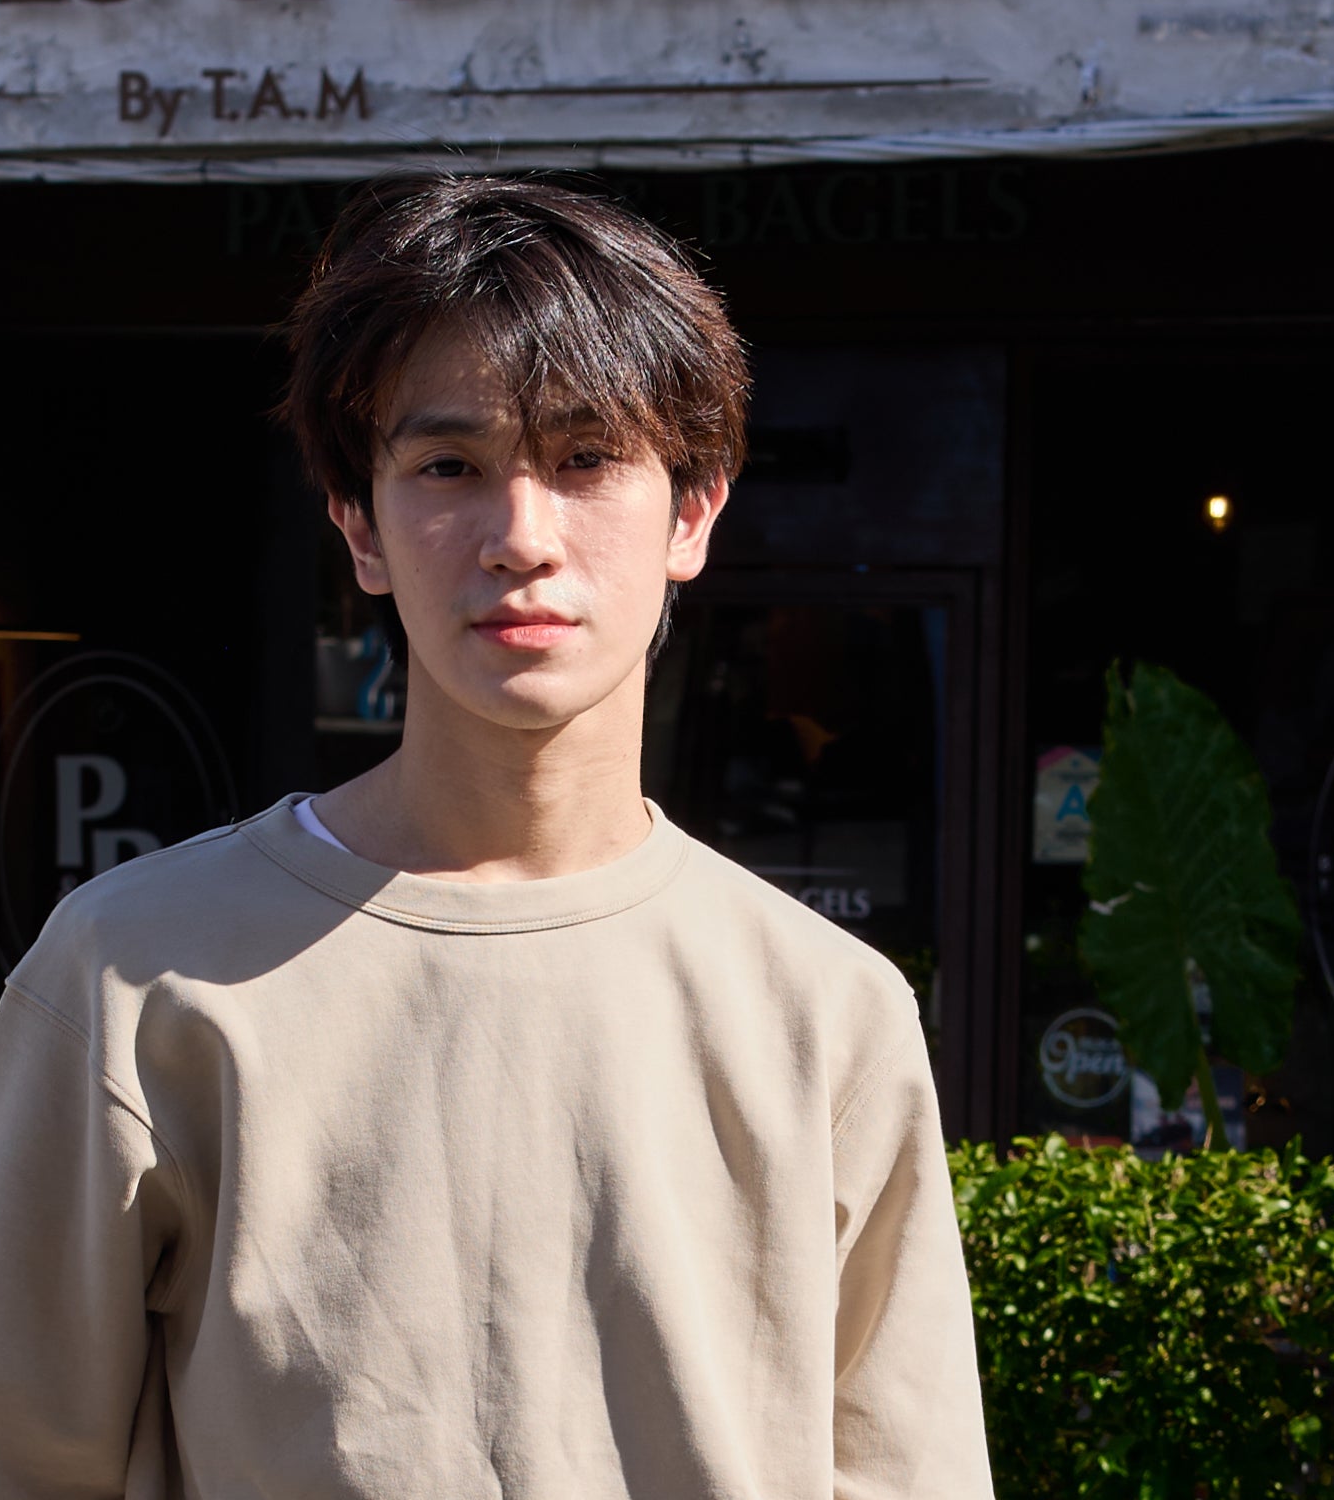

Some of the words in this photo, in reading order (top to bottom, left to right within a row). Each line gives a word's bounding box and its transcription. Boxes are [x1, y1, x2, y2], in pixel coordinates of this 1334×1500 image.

[118, 70, 185, 137] By
[698, 163, 1034, 248] BAGELS
[1055, 783, 1090, 822] A
[789, 886, 873, 920] GELS
[1045, 1030, 1126, 1084] Open
